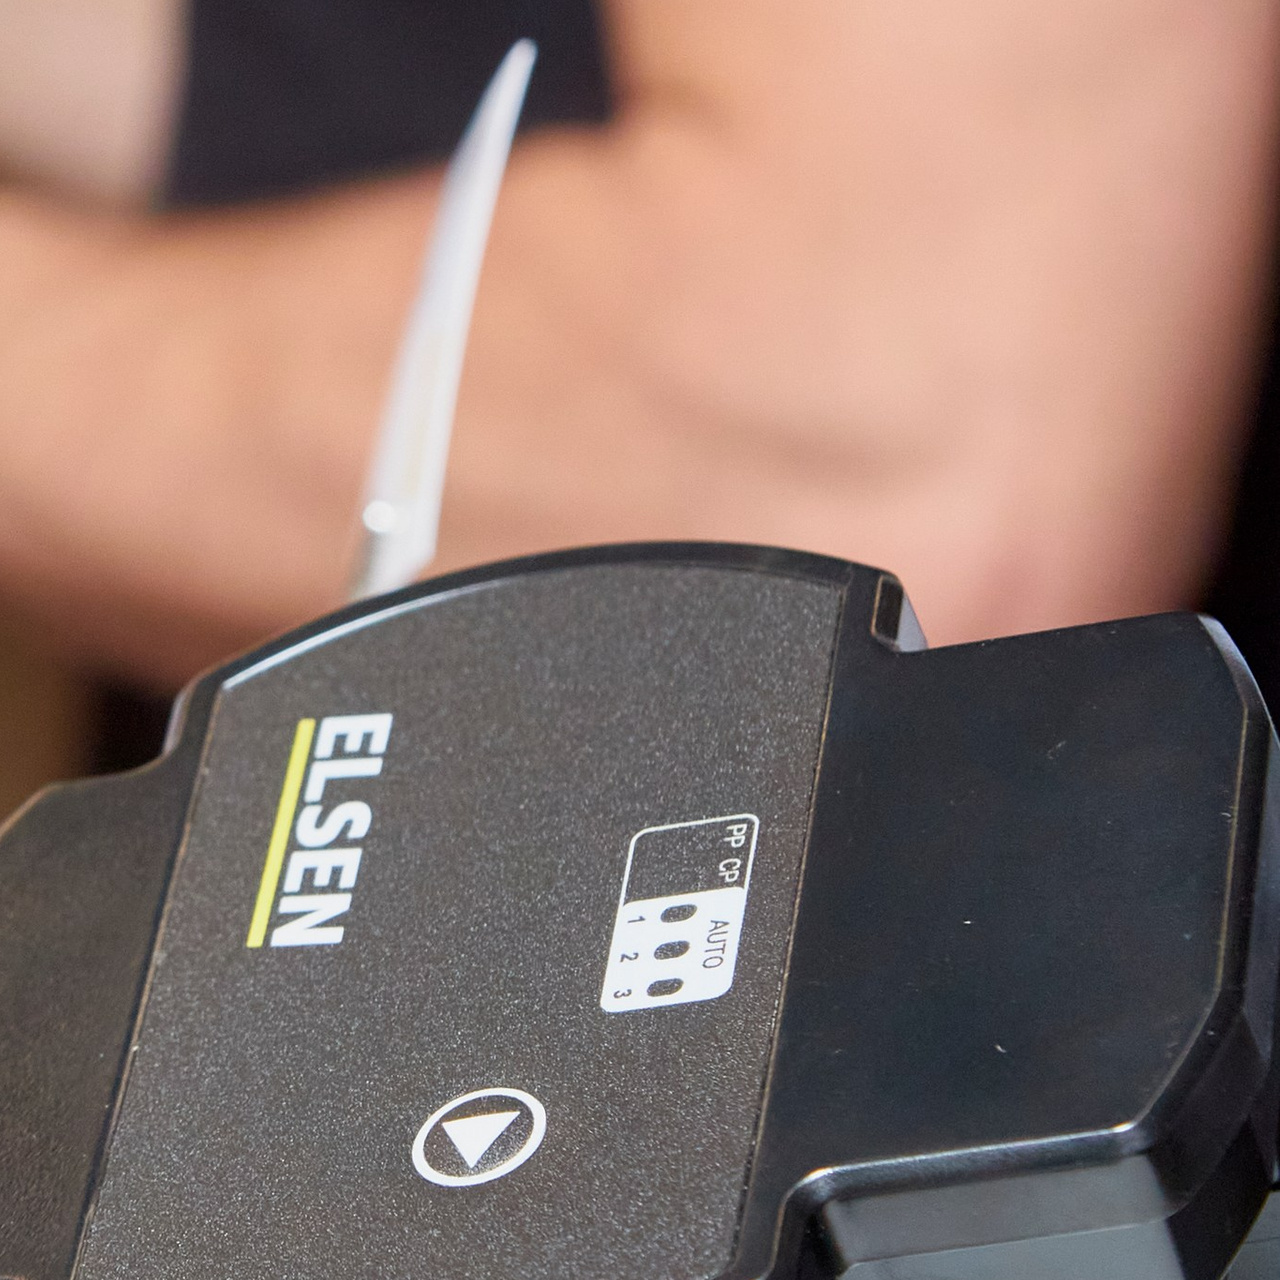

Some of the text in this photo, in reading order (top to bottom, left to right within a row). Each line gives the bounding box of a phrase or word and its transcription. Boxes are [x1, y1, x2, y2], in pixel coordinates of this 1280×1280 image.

[270, 713, 393, 947] ELSEN
[702, 823, 747, 969] PP CP AUTO
[613, 915, 646, 999] 1 2 3
